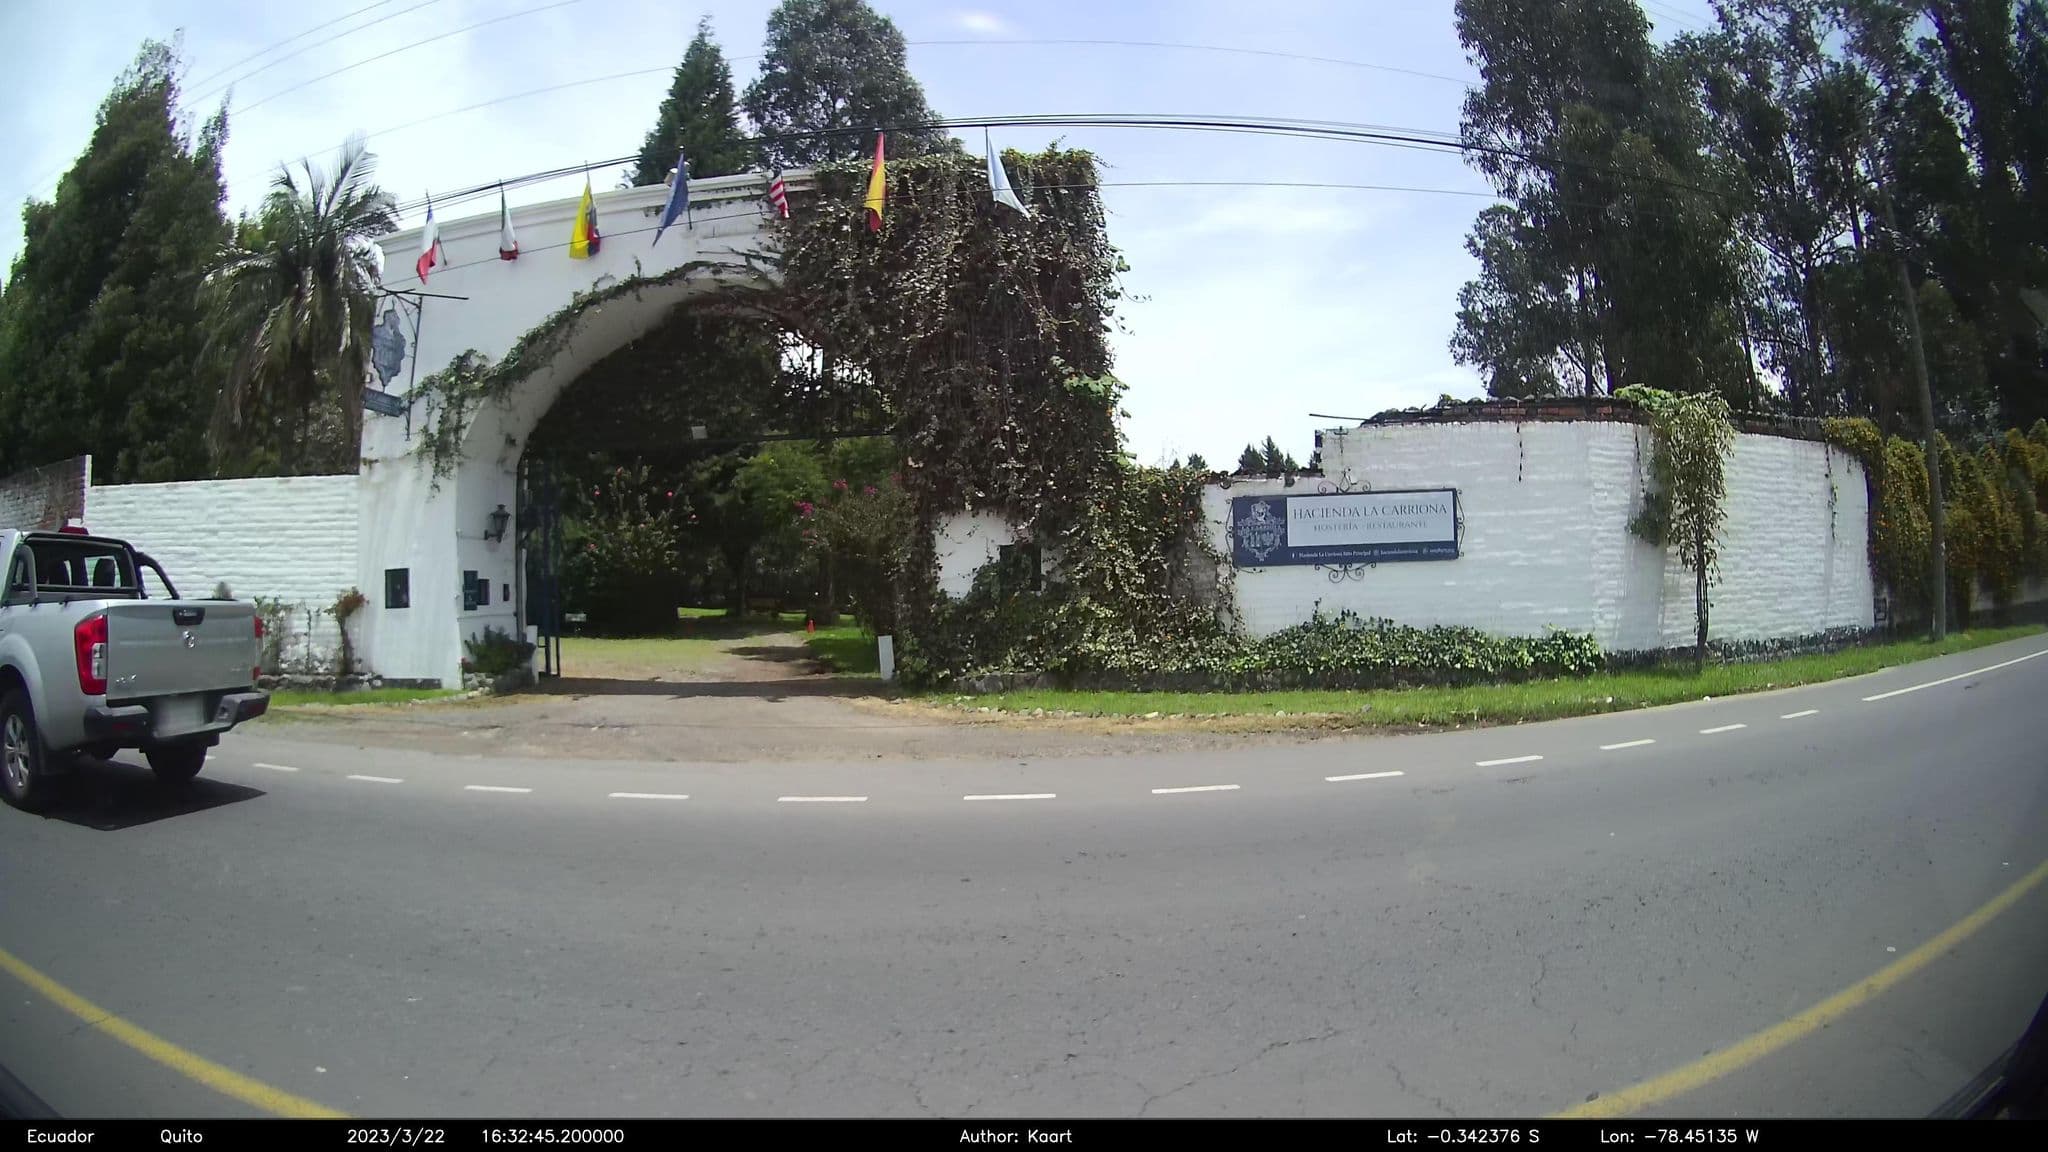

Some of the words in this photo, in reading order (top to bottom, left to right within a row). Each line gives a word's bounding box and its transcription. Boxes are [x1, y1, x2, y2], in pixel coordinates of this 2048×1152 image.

[1293, 507, 1360, 519] HACIENDA
[1363, 506, 1378, 517] LA
[1380, 504, 1447, 516] CARRIONA
[1366, 520, 1427, 530] RESTAURANTE
